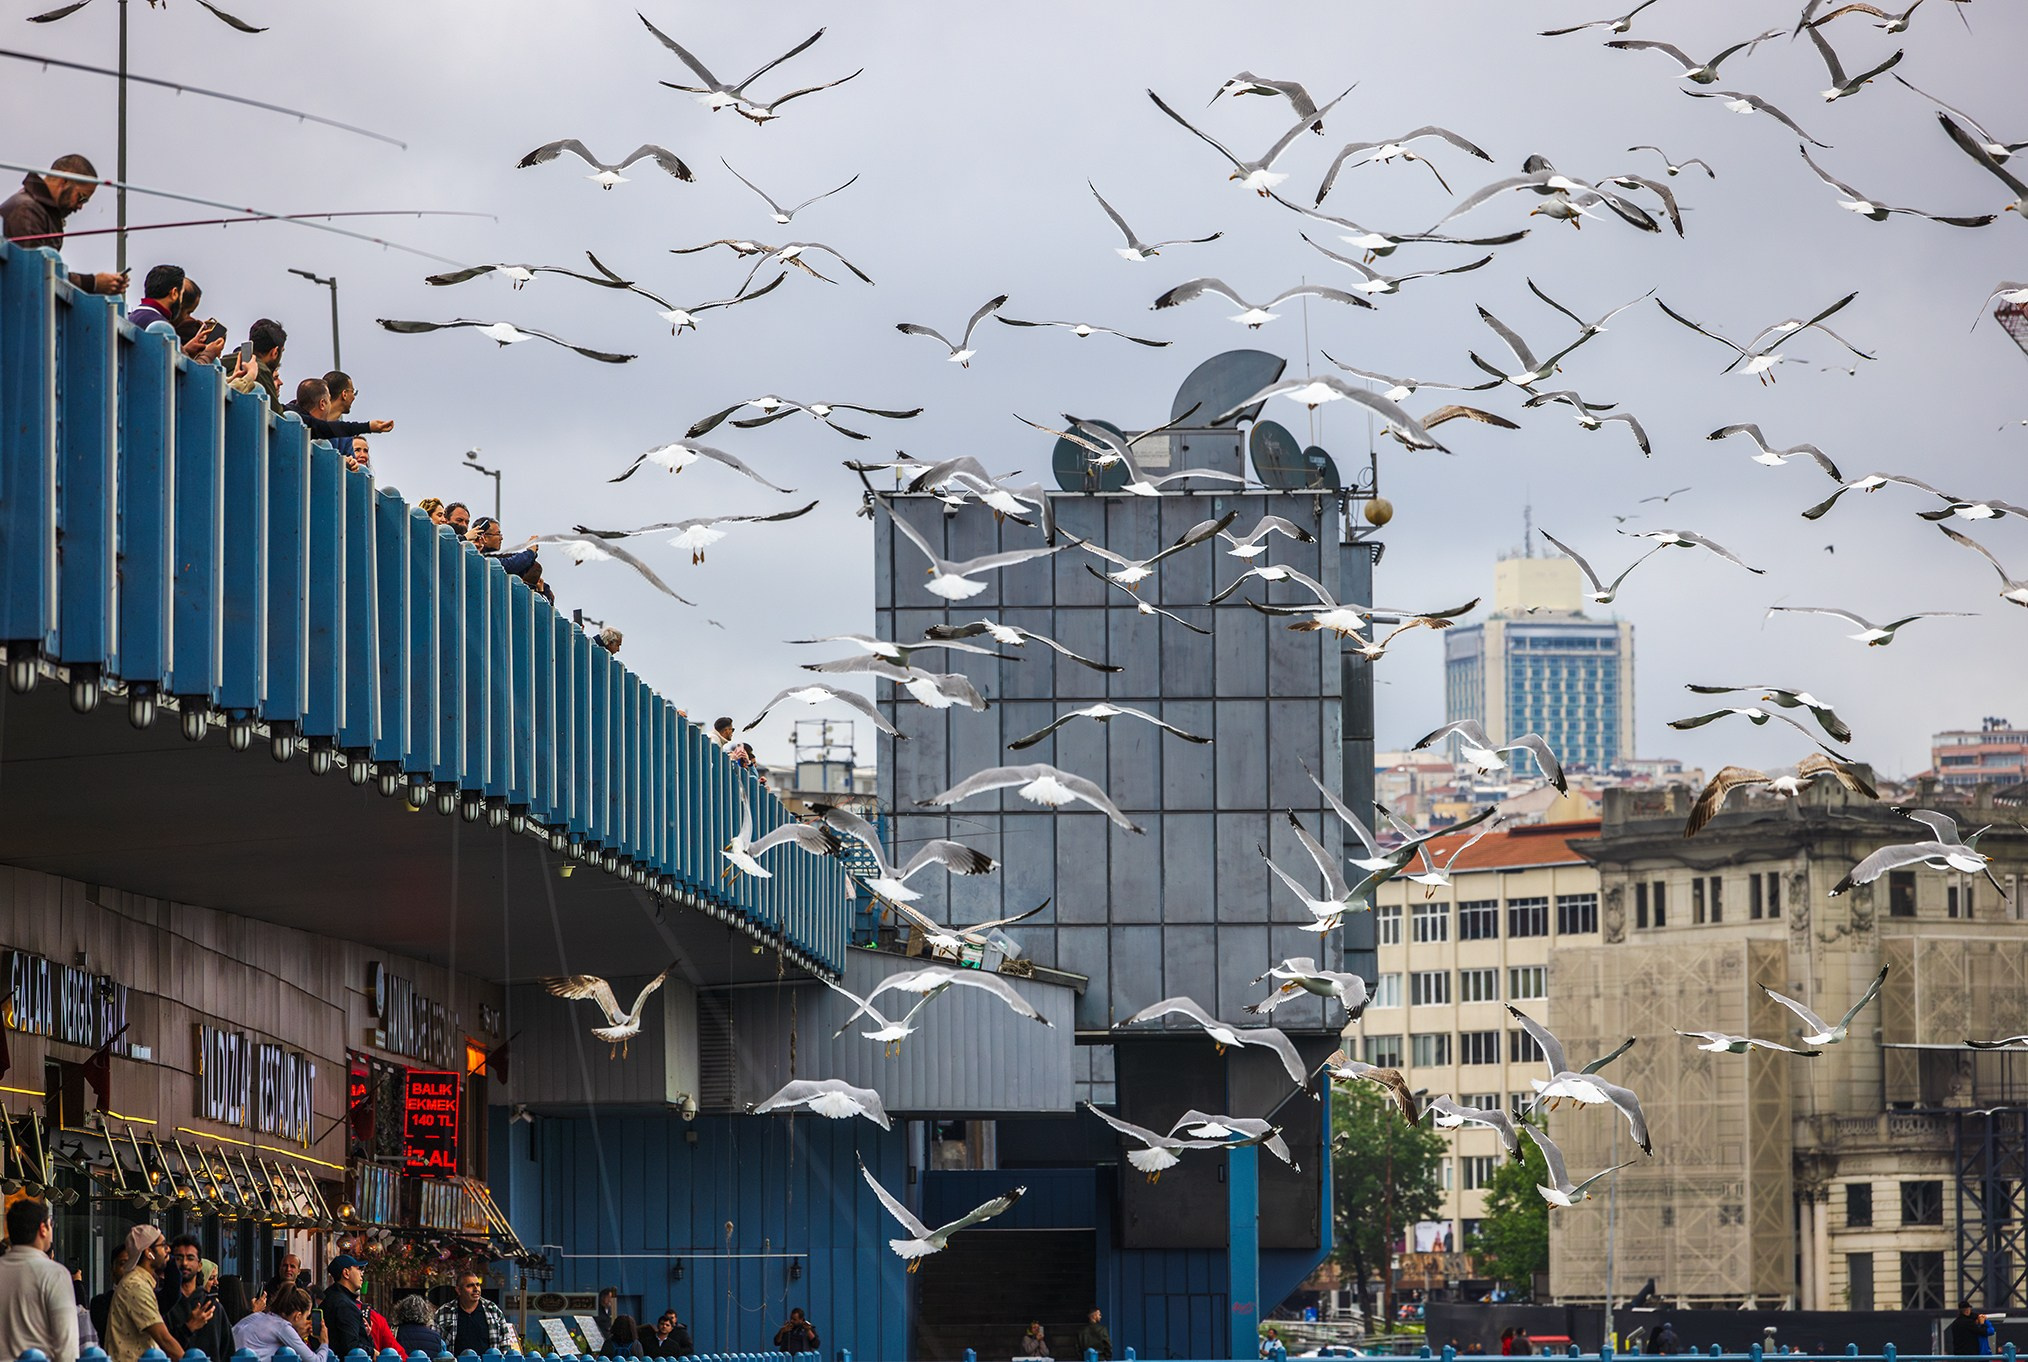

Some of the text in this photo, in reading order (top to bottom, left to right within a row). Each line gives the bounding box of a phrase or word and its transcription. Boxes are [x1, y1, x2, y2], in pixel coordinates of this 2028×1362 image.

[11, 951, 53, 1036] GALATA
[200, 1023, 316, 1147] YILDIZLAR RESTAURANT
[411, 1082, 453, 1096] BALIK
[406, 1098, 456, 1112] EKMEK
[412, 1113, 454, 1127] 140 TL
